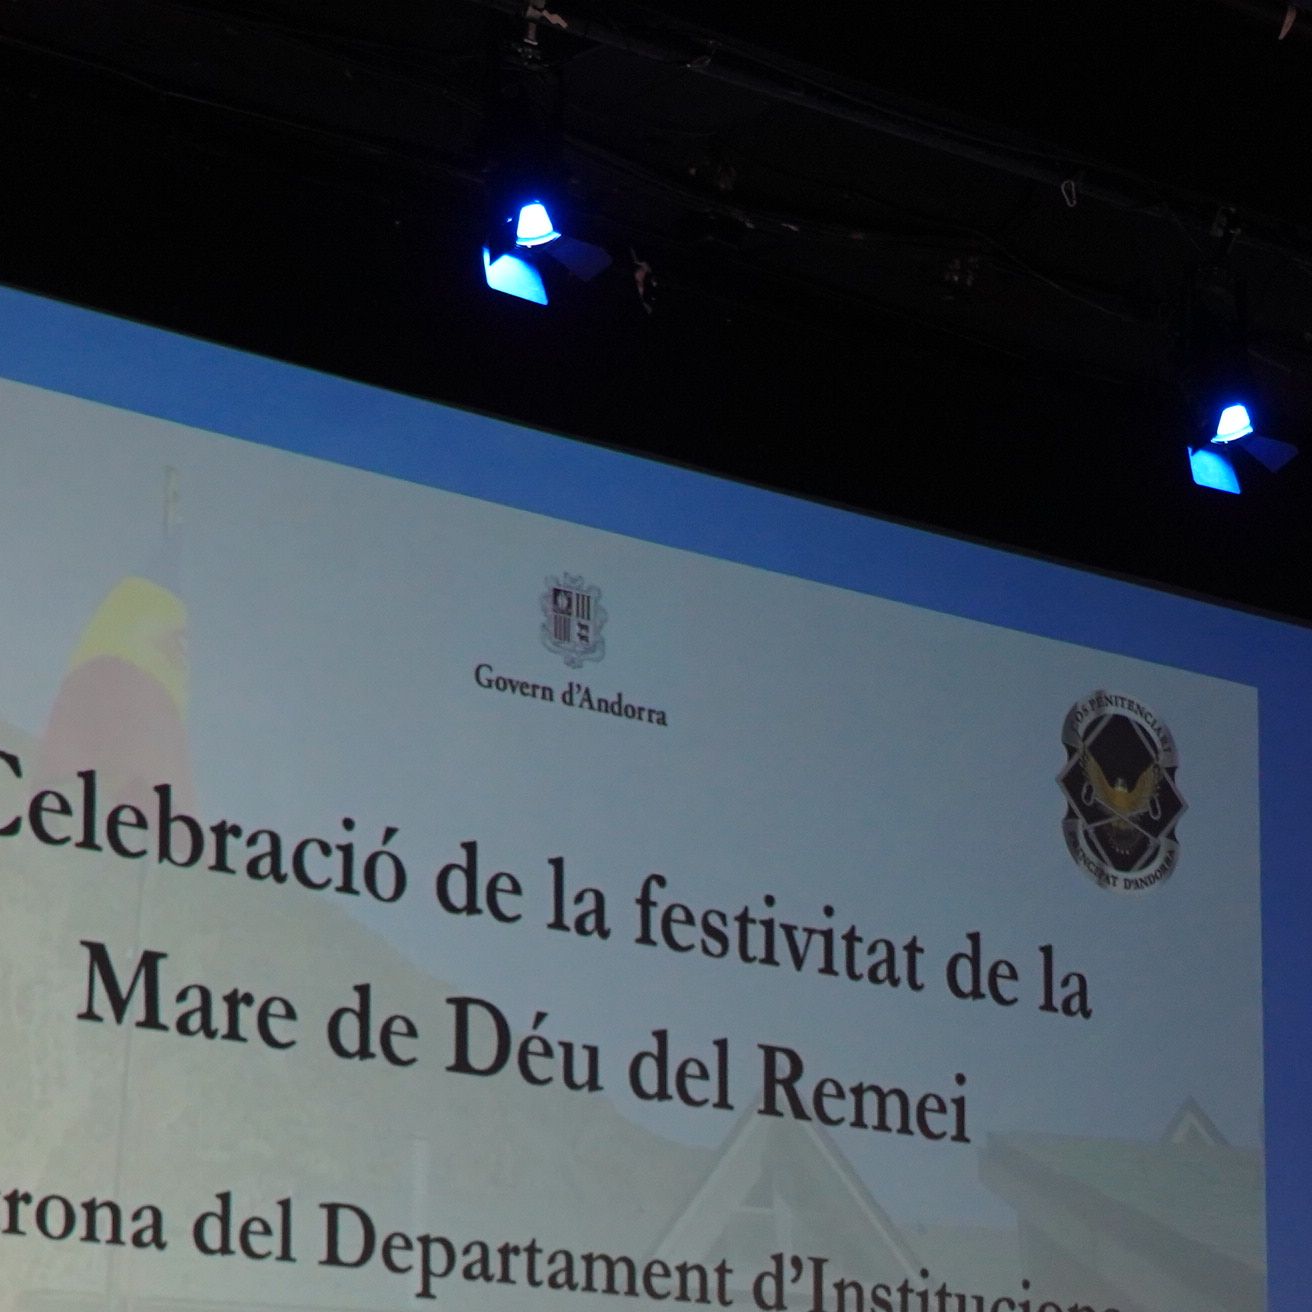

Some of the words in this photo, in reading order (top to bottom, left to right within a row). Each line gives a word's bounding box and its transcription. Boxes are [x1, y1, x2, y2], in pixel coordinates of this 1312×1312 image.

[473, 662, 555, 703] Govern
[560, 680, 669, 727] d'Andorra
[436, 840, 523, 924] de
[546, 856, 611, 941] la
[634, 873, 925, 992] festivitat
[946, 931, 1019, 1007] de
[1038, 943, 1093, 1020] la
[76, 939, 298, 1050] Mare
[326, 983, 419, 1068] de
[445, 996, 604, 1094] Déu
[628, 1028, 735, 1111] del
[757, 1043, 971, 1144] Remei
[192, 1190, 297, 1264] del
[318, 1202, 734, 1307] Departament
